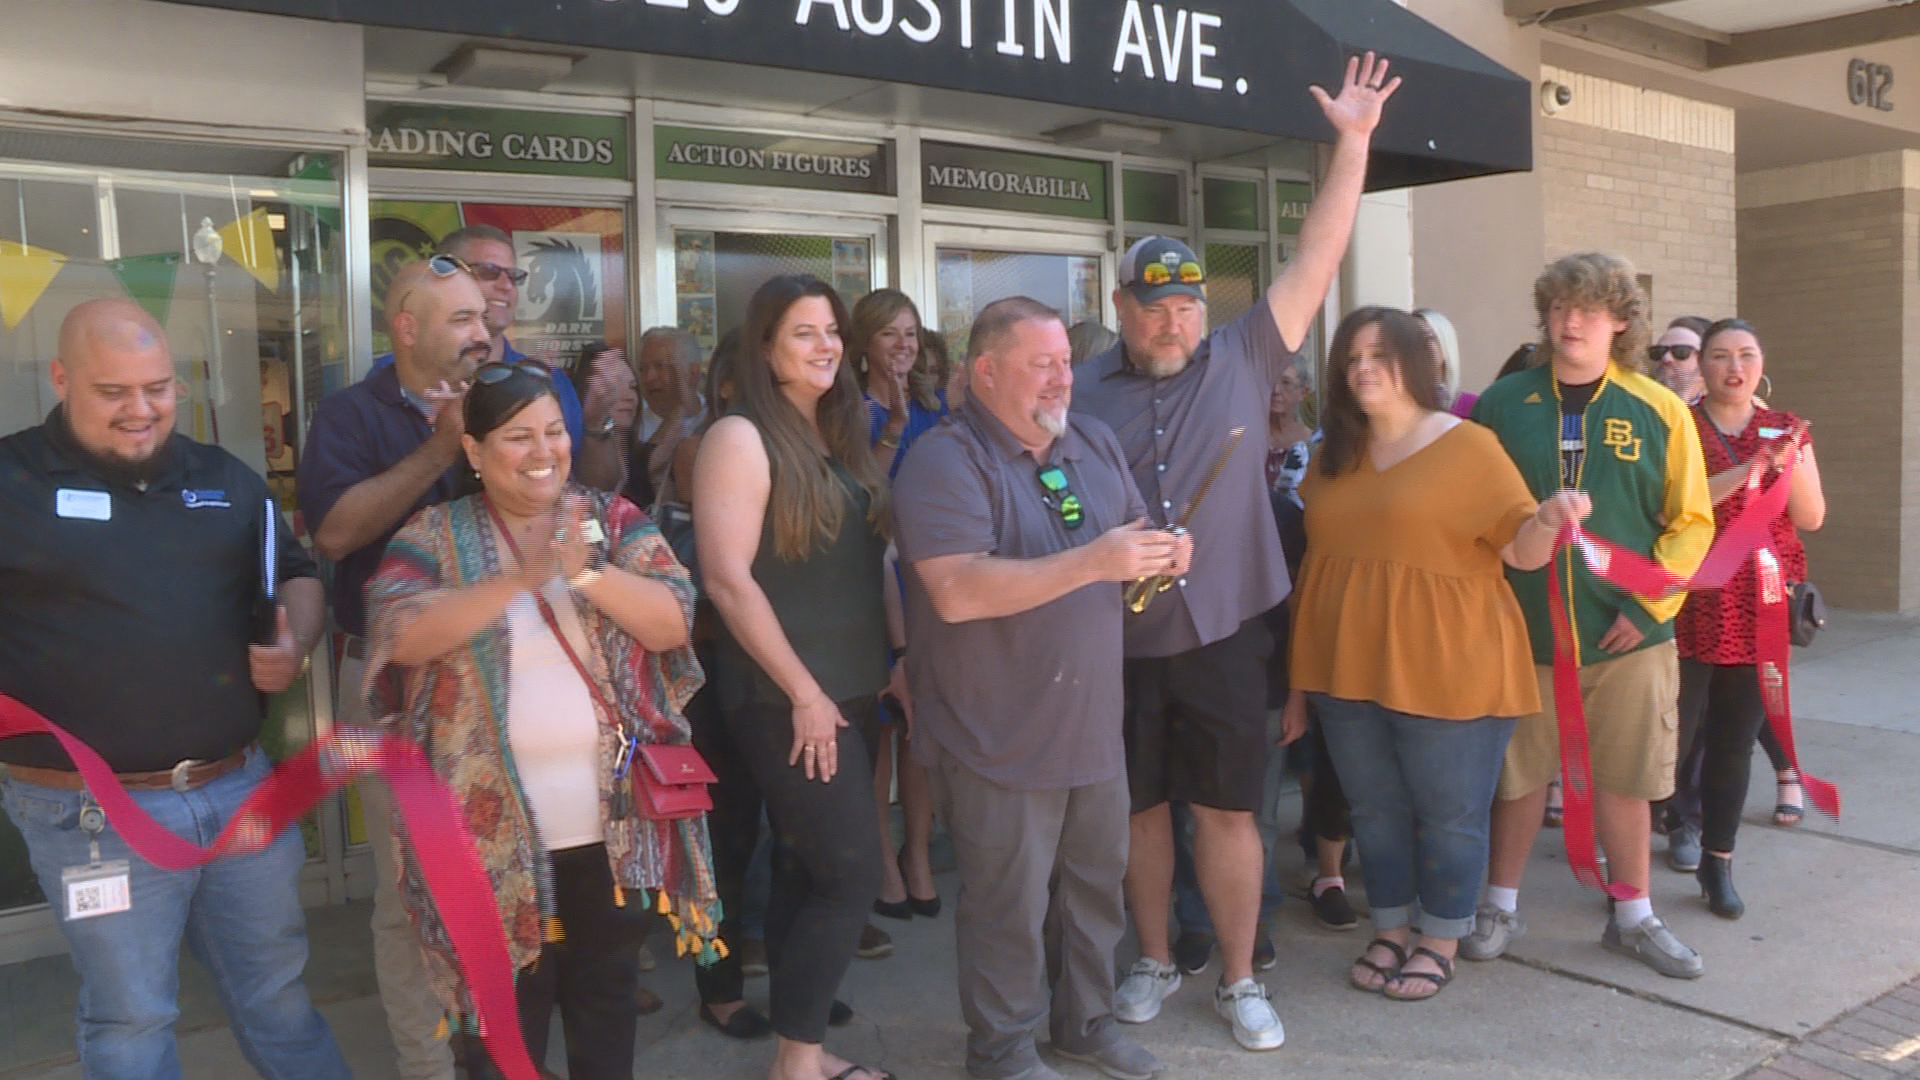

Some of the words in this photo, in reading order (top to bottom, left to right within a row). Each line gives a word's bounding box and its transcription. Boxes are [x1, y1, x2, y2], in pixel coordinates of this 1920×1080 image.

[1112, 0, 1248, 95] AVE.
[1847, 58, 1895, 112] 612
[502, 132, 613, 164] CARDS
[668, 142, 766, 168] ACTION
[771, 150, 871, 178] FIGURES
[929, 165, 1092, 201] MEMORABILIA
[545, 322, 593, 334] DARK
[1603, 417, 1642, 462] BU
